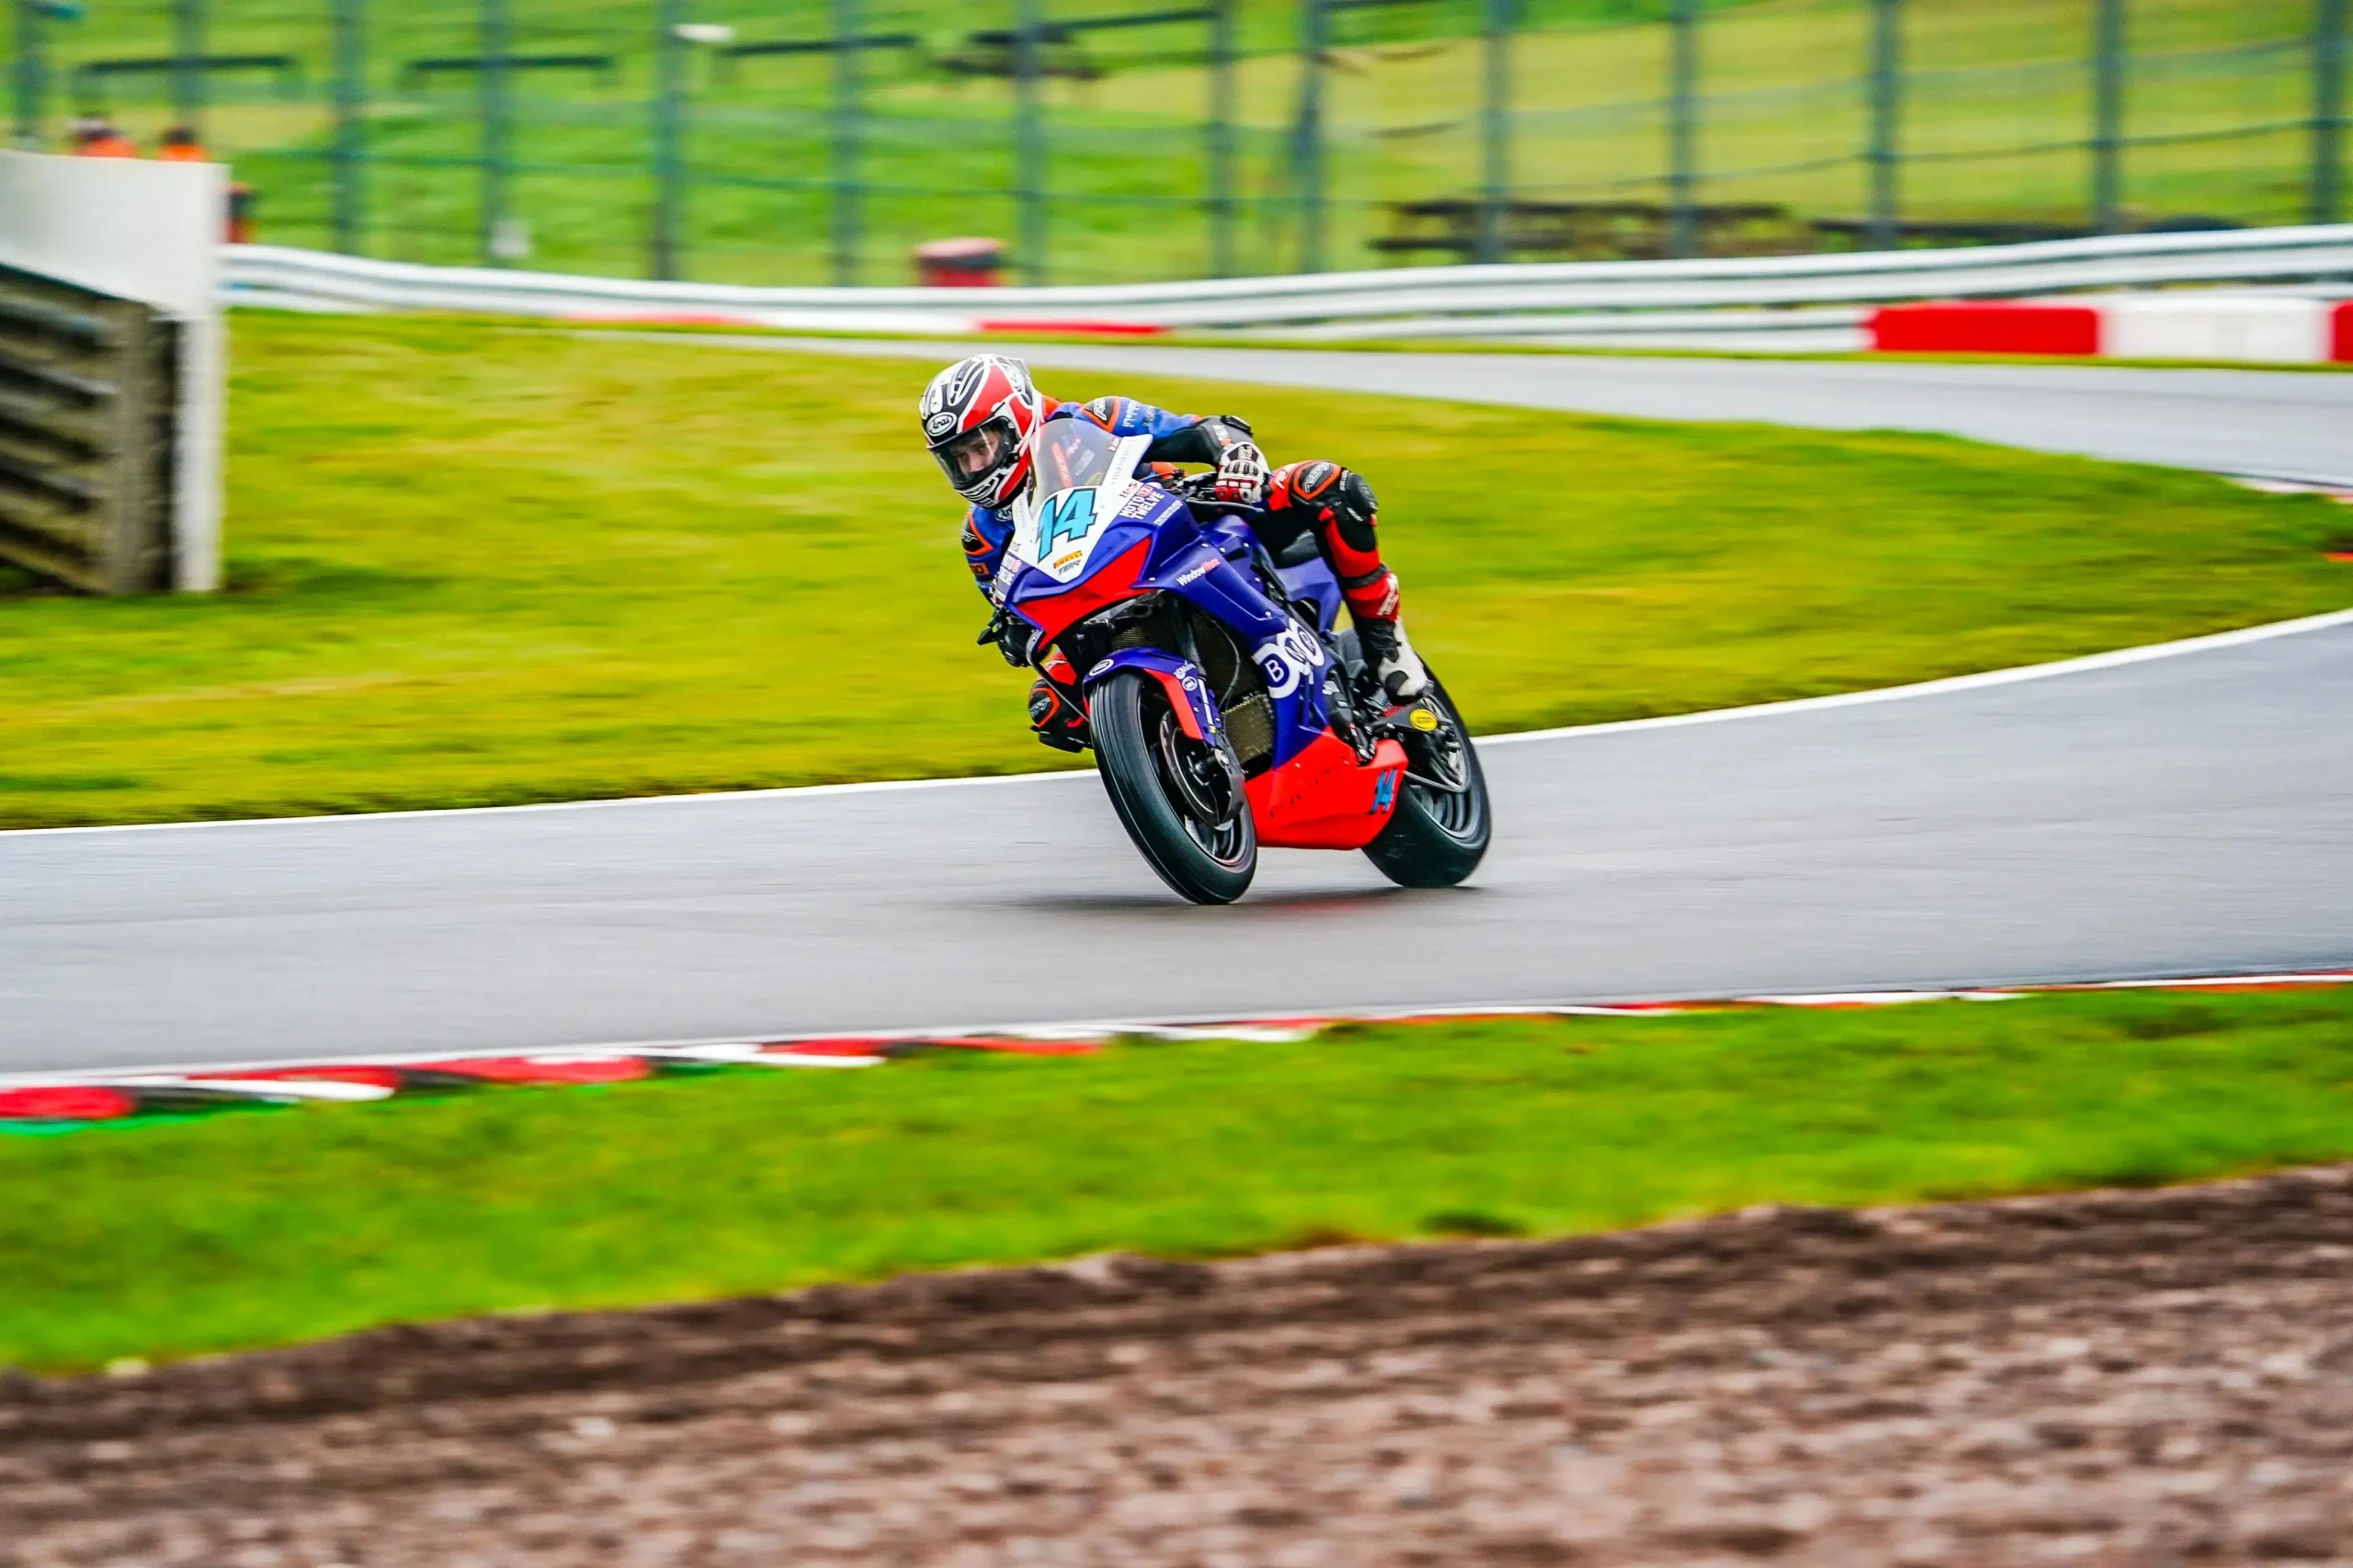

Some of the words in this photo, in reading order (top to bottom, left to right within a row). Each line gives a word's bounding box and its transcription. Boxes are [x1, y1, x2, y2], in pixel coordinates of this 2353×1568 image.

[1119, 495, 1145, 517] MOTO
[1132, 491, 1165, 520] TWELVE
[1036, 488, 1097, 563] 14
